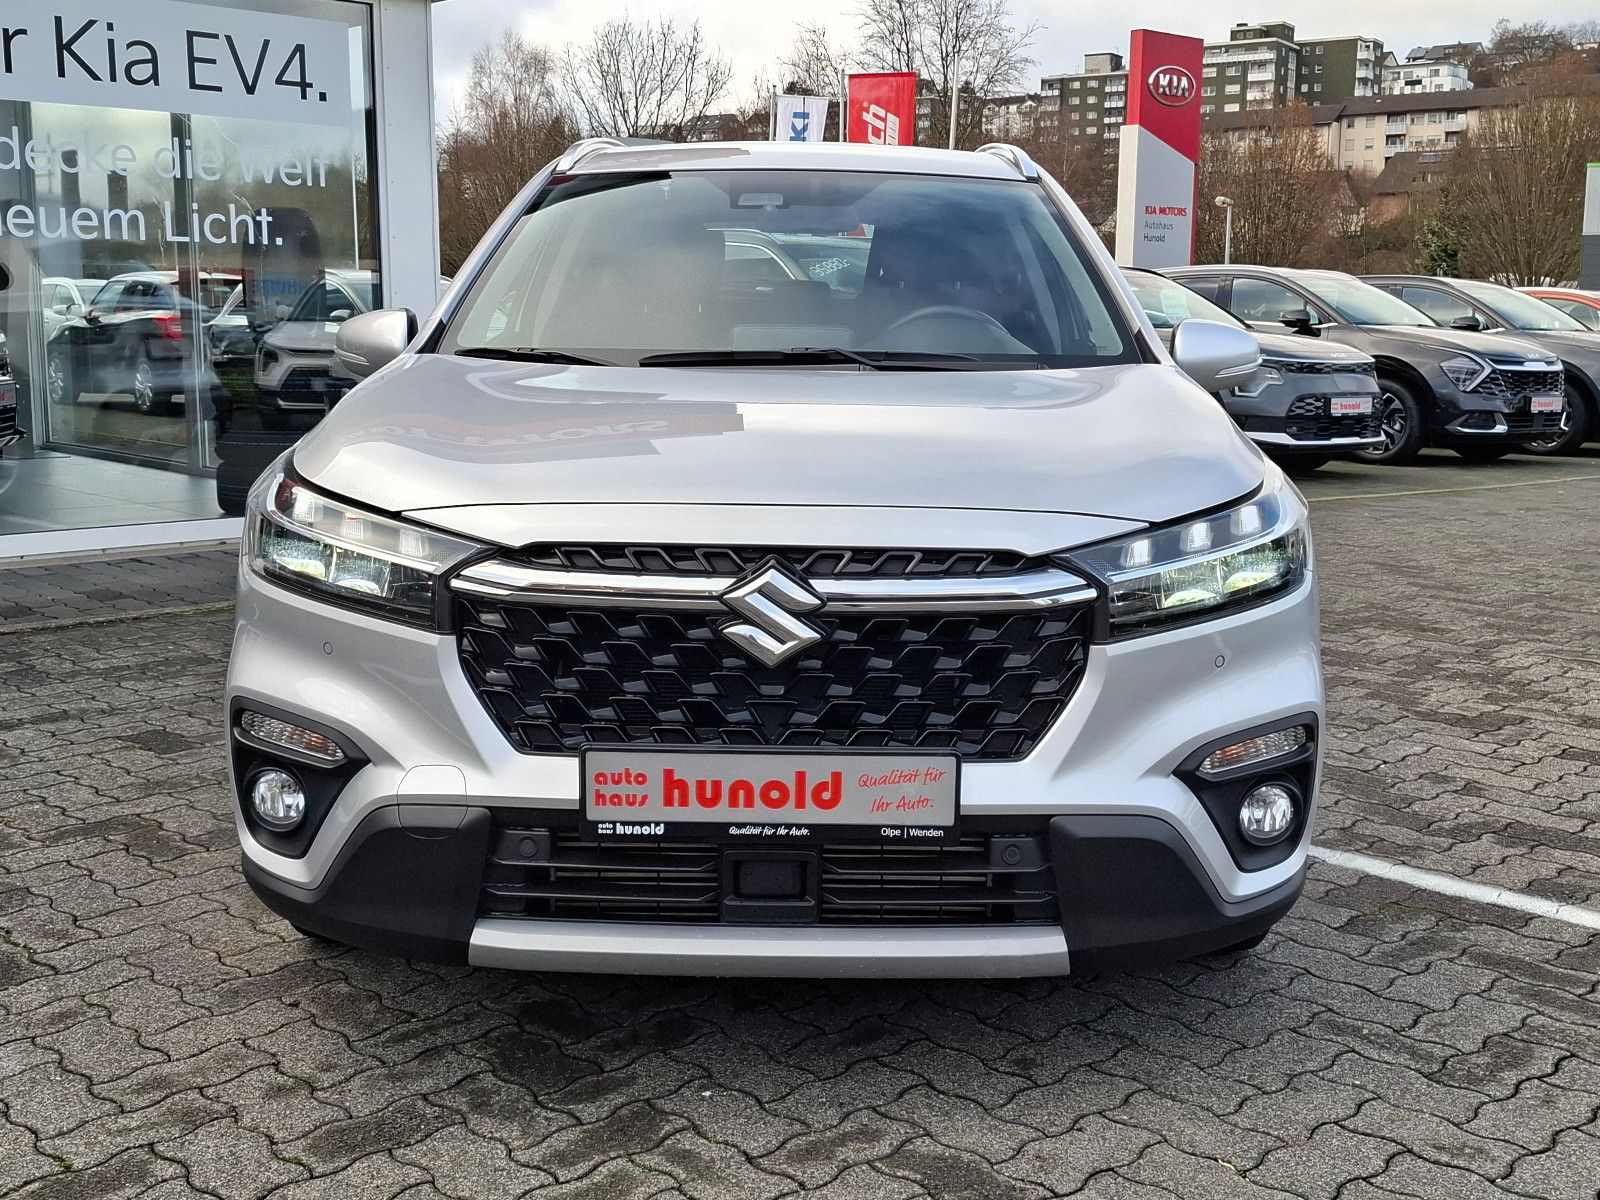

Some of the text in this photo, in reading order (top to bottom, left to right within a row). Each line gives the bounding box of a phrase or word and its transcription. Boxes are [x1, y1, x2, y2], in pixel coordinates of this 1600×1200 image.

[53, 15, 160, 86] Kia
[186, 30, 328, 102] EV4.
[1157, 73, 1189, 98] KIA
[154, 137, 222, 182] die
[240, 148, 332, 188] Welt
[1158, 206, 1188, 217] MOTORS
[0, 200, 284, 245] euem Licht.
[1144, 220, 1174, 231] Autohaus
[1143, 232, 1166, 243] Hunold
[593, 768, 648, 786] auto
[857, 766, 946, 788] Qualität für
[594, 788, 649, 807] haus
[662, 768, 843, 810] hunold
[869, 795, 934, 813] Ihr Auto.
[615, 822, 665, 835] hunold
[729, 825, 810, 837] Qualität für Ihr Auto.
[881, 827, 901, 837] Olpe
[909, 828, 944, 837] Wenden
